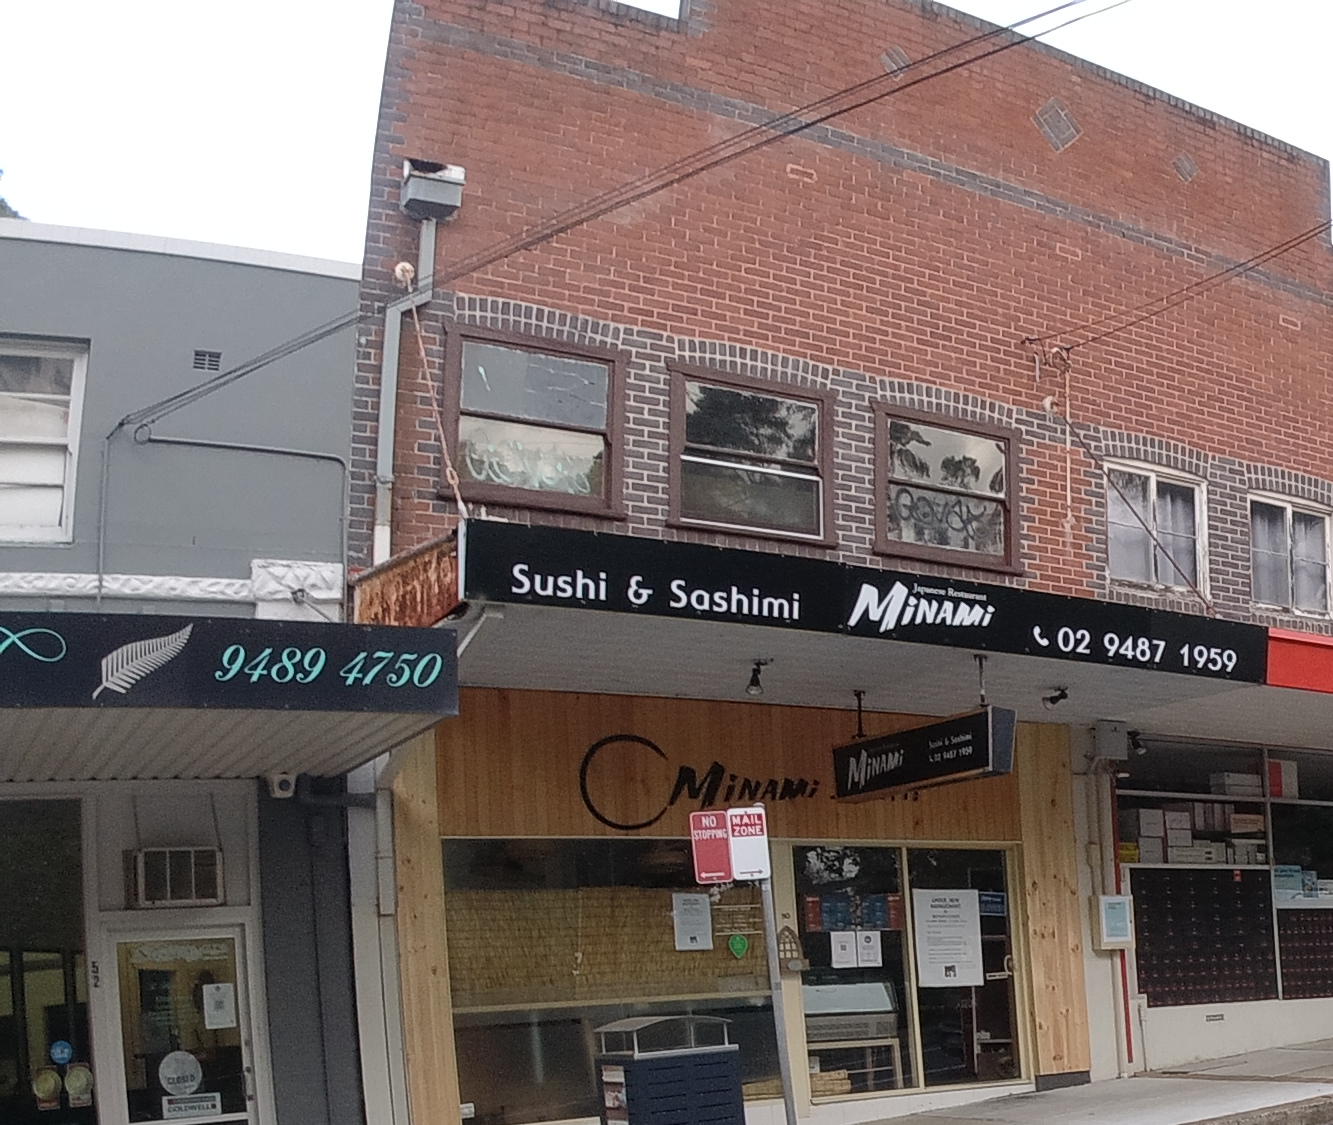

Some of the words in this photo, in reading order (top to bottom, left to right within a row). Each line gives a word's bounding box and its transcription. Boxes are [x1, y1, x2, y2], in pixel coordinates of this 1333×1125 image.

[510, 563, 607, 602] Sushi
[627, 575, 653, 604] &
[669, 580, 800, 620] Sashimi
[1057, 626, 1091, 654] 02
[1103, 633, 1166, 663] 9487
[1179, 643, 1238, 673] 1959
[214, 644, 326, 684] 9489
[339, 651, 443, 688] 4750
[701, 815, 716, 828] NO
[732, 814, 762, 826] MAIL
[693, 828, 728, 841] STOPPING
[733, 825, 763, 837] ZONE
